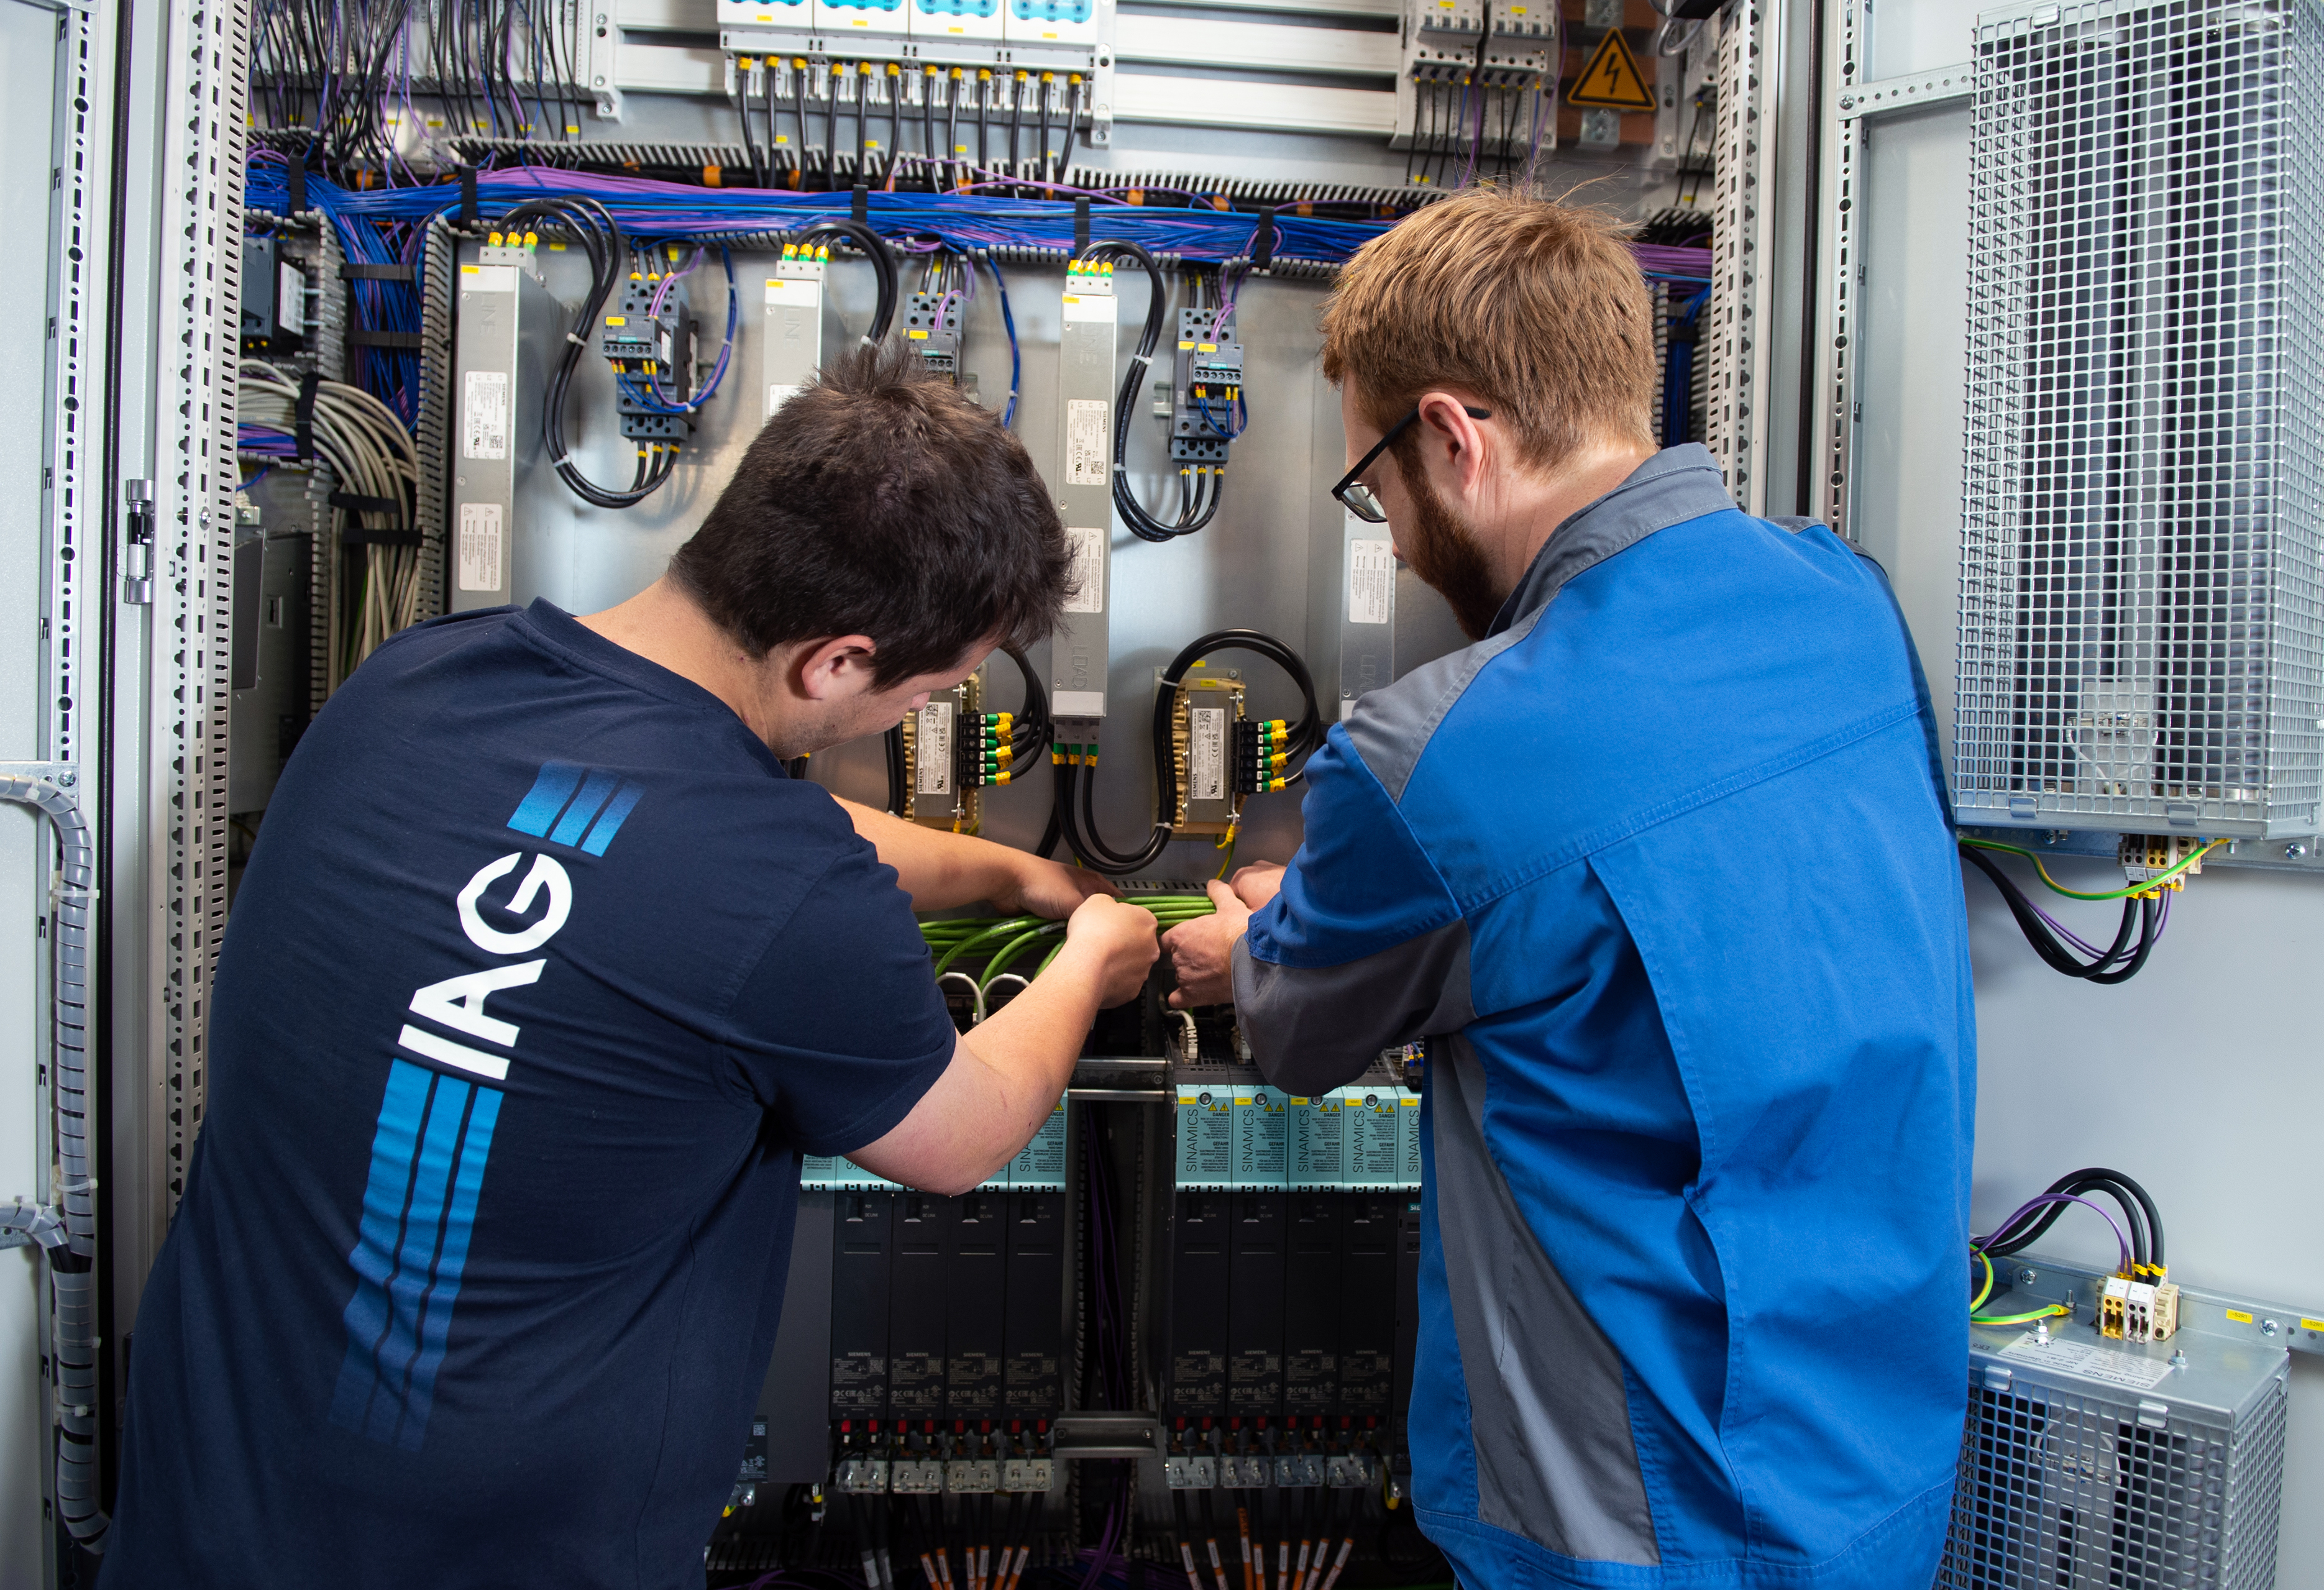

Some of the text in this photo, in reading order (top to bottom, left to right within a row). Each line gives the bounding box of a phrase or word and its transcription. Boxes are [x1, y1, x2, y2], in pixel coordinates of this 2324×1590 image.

[480, 293, 496, 336] LINE
[784, 307, 800, 350] LINE
[1073, 646, 1088, 690] LOAD
[398, 852, 572, 1081] IAG
[1186, 1109, 1198, 1172] SINAMICS
[1242, 1109, 1253, 1172] SINAMICS
[1298, 1110, 1309, 1172] SINAMICS
[1353, 1110, 1364, 1173] SINAMICS
[1408, 1110, 1419, 1172] SINAMICS
[2006, 1351, 2041, 1361] Germany
[2083, 1369, 2150, 1387] SIEMENS
[2090, 1366, 2154, 1382] Braking Resistor
